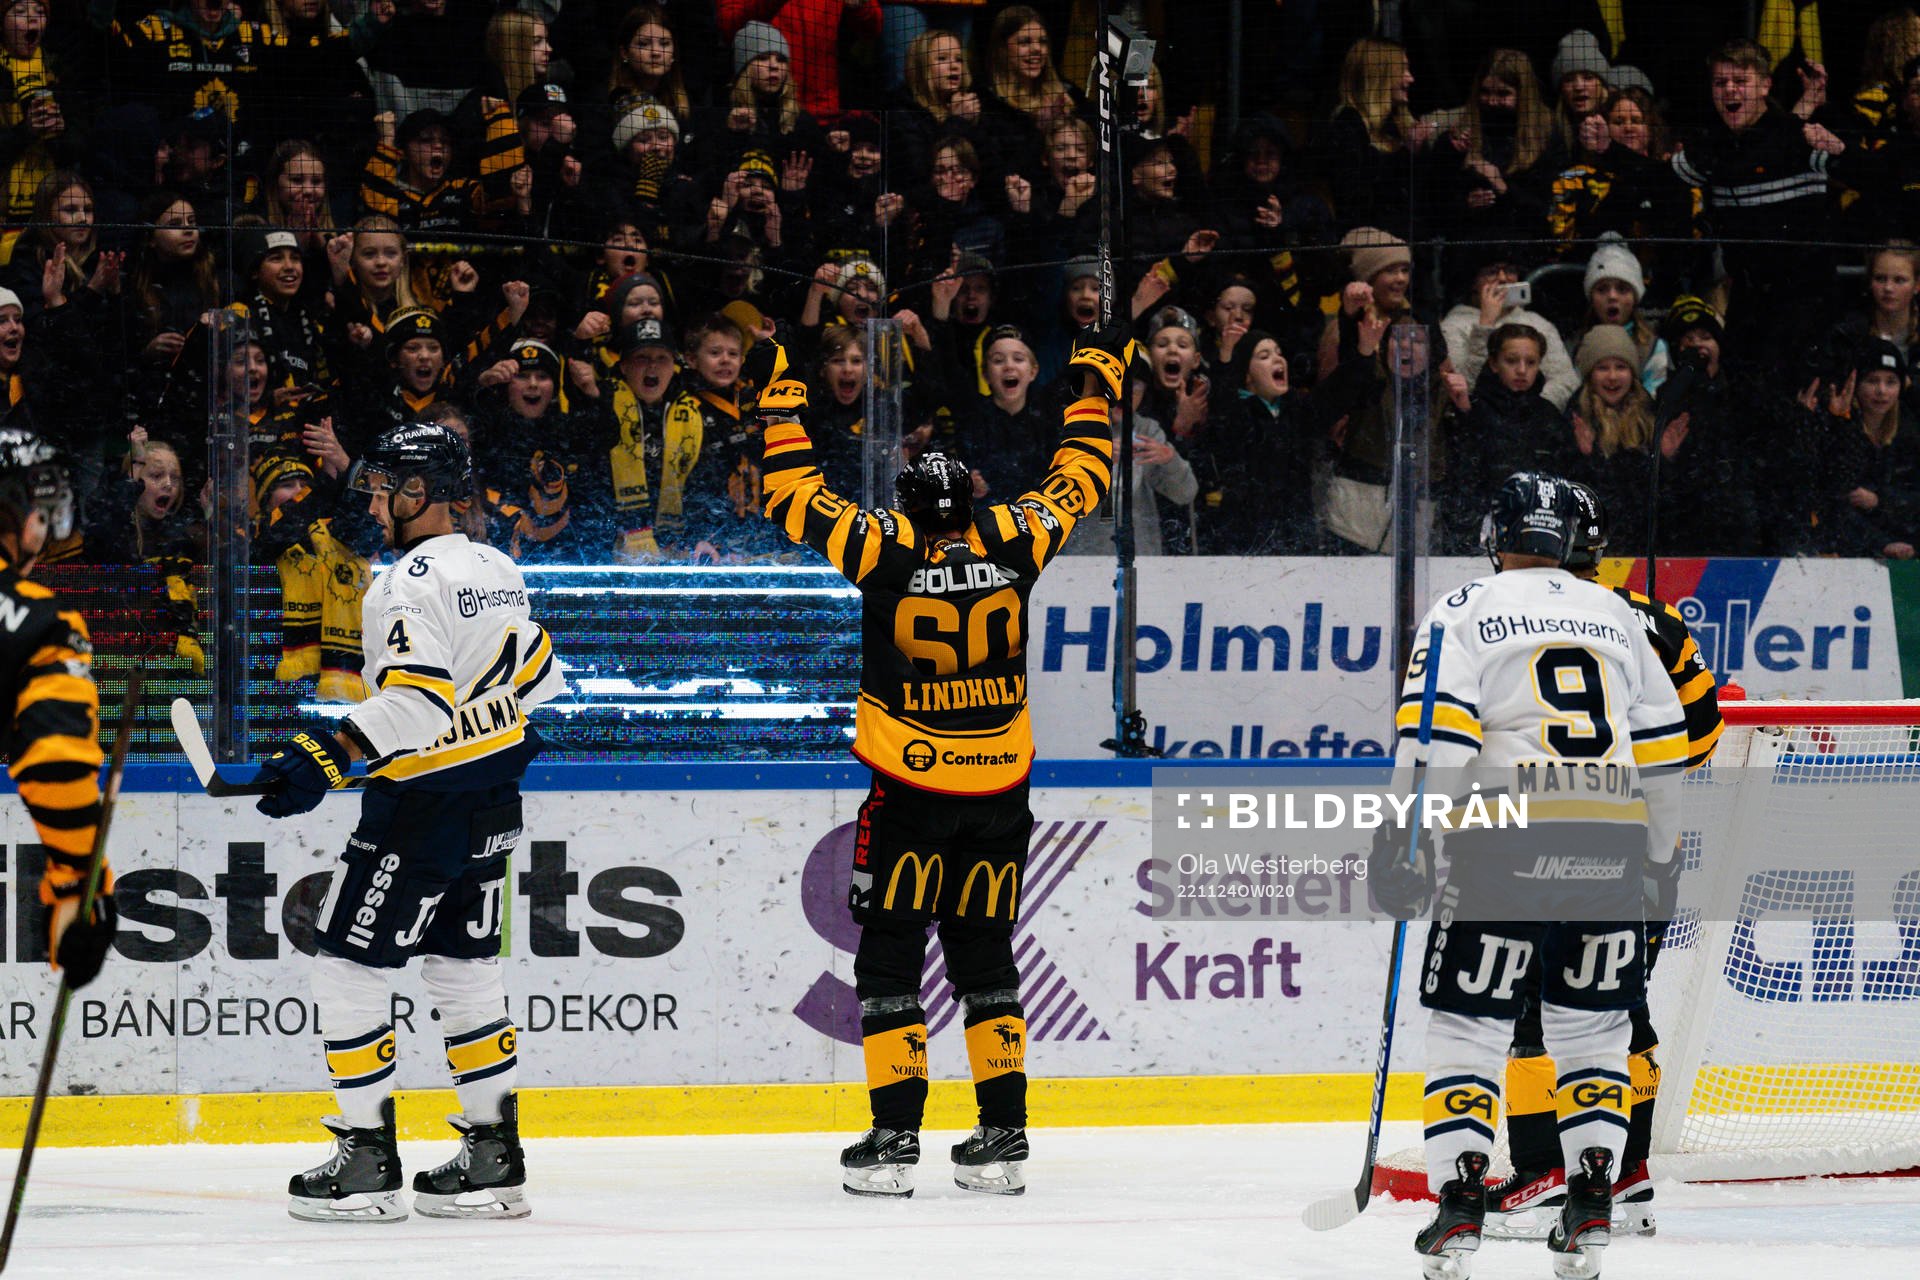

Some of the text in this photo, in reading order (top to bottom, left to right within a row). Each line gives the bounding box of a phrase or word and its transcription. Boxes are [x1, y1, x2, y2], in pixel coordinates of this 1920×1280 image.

[1099, 51, 1111, 152] CCM
[404, 425, 444, 440] RAVEMA
[938, 499, 952, 508] 60
[1588, 526, 1599, 536] 40
[386, 619, 413, 655] 4
[894, 587, 1022, 676] 60
[1042, 602, 1396, 673] Holmlu
[1508, 615, 1630, 649] Husqvarna
[1675, 596, 1872, 673] åleri
[424, 691, 519, 750] JALMA
[1530, 643, 1617, 761] 9
[292, 732, 343, 787] BAUER
[941, 750, 1019, 767] Contractor
[1152, 725, 1396, 758] kellefte
[1516, 762, 1631, 799] MATSON
[1135, 938, 1301, 1001] Kraft
[1456, 933, 1534, 1000] JP
[1562, 929, 1636, 991] JP
[503, 993, 679, 1032] LDEKOR
[1444, 1089, 1493, 1120] GA
[1572, 1082, 1623, 1109] GA
[1504, 1176, 1555, 1209] CCM
